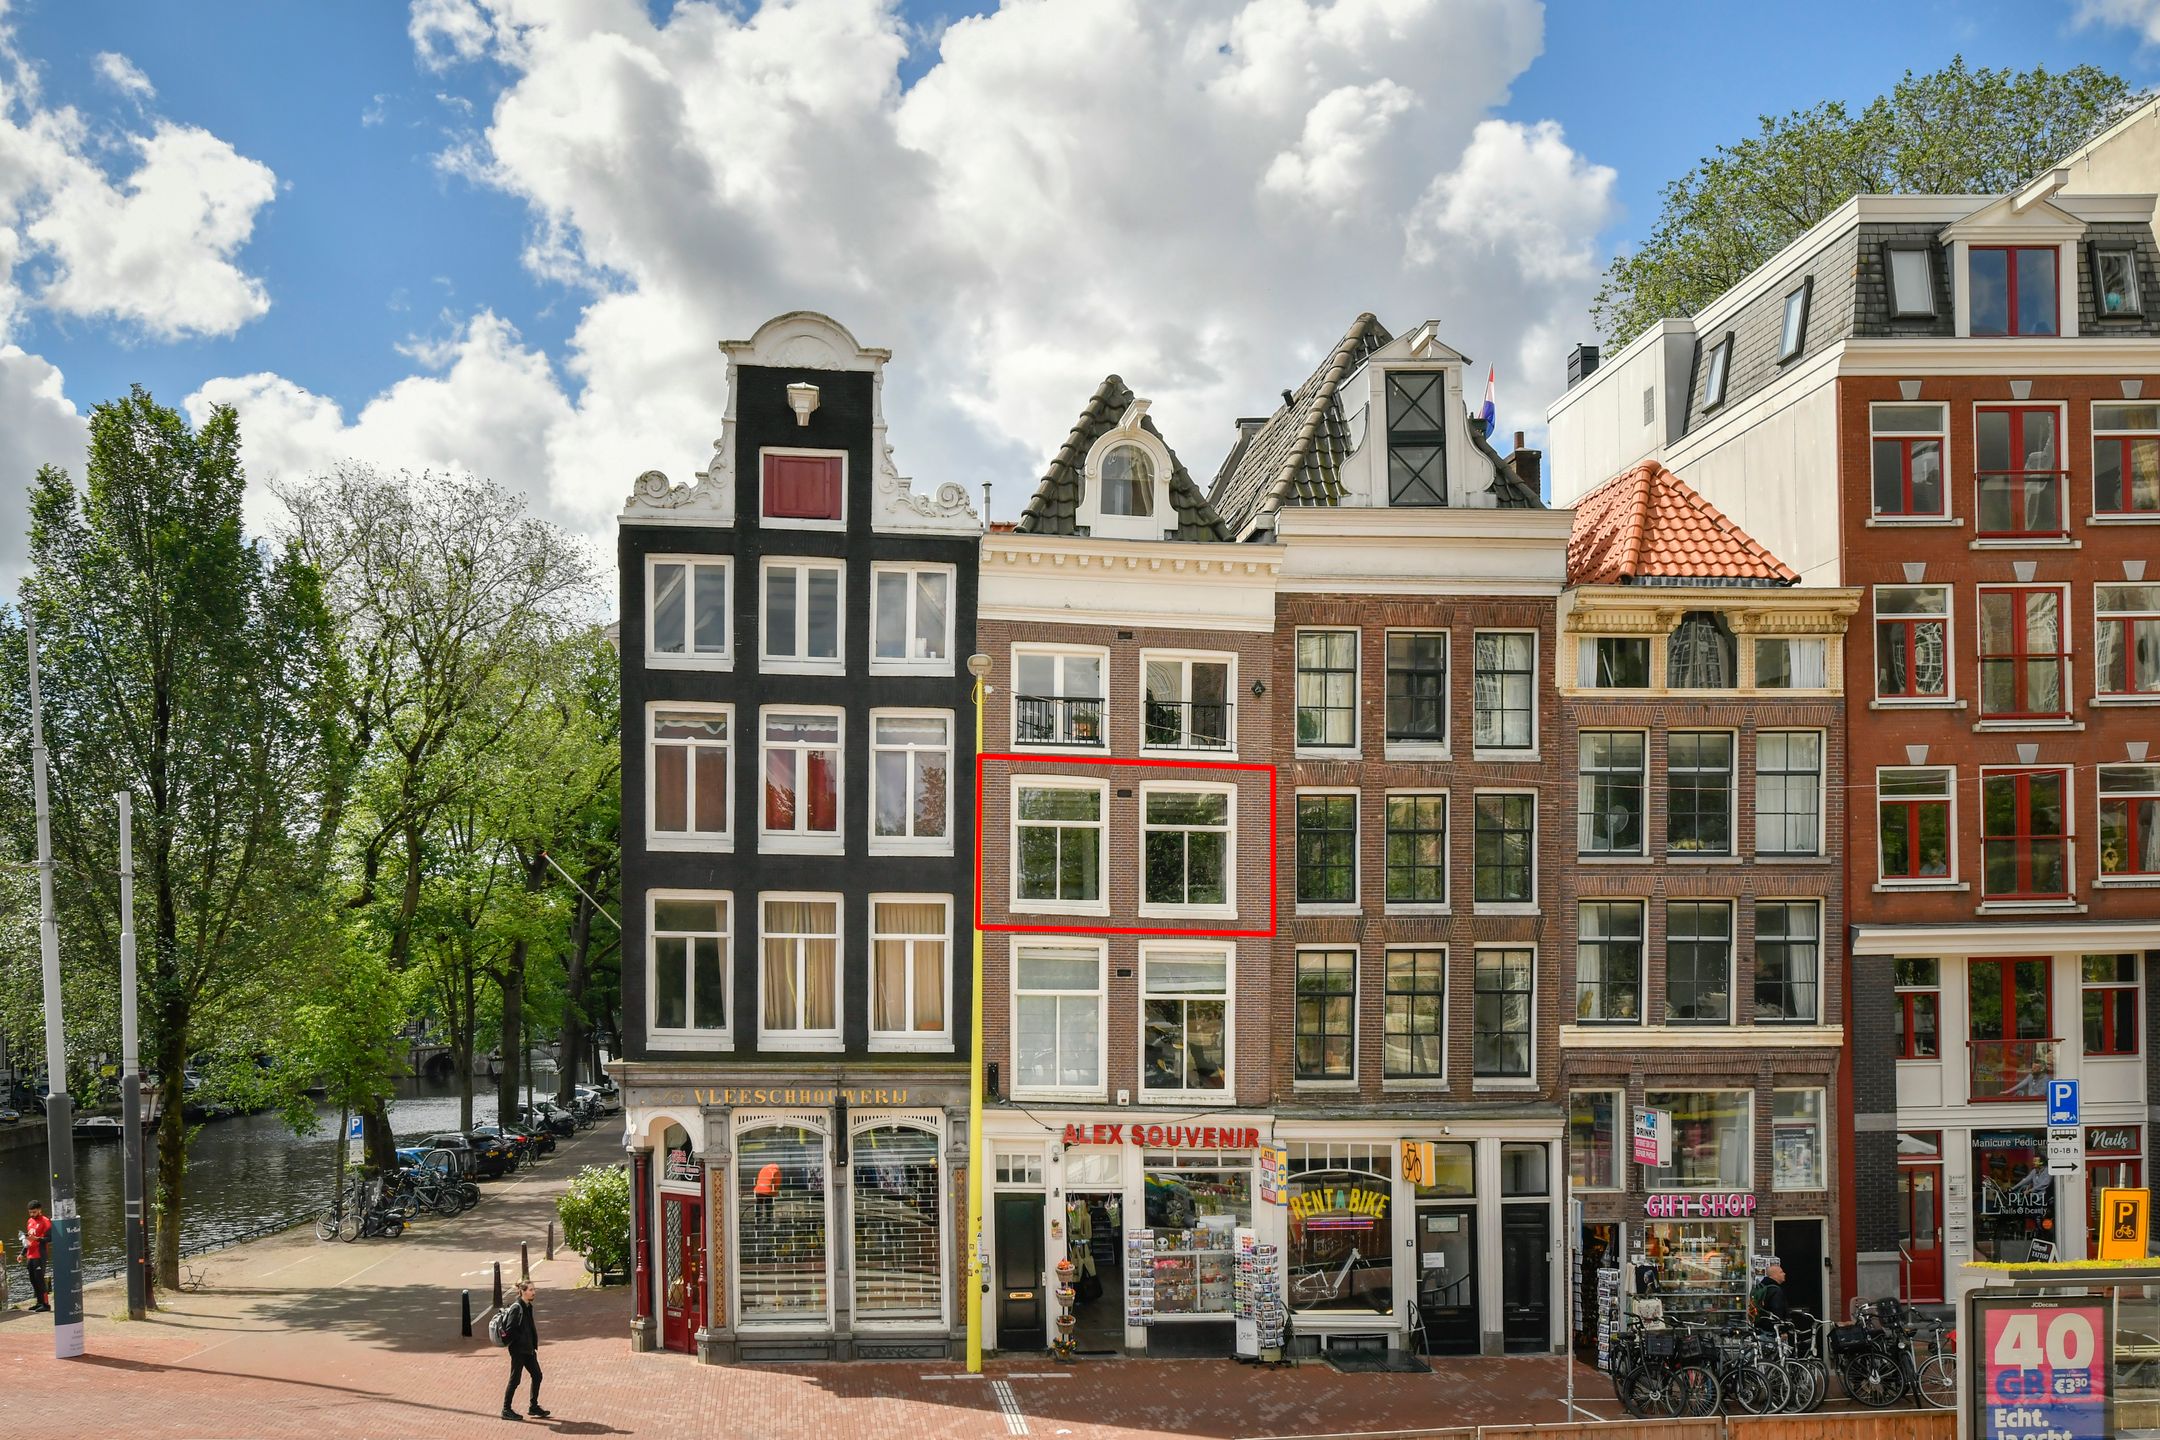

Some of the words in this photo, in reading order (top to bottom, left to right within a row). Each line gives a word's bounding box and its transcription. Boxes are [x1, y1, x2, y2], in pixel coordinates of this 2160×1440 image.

[694, 1087, 908, 1105] VLEESCHHOUWERIJ
[2056, 1084, 2072, 1107] P
[352, 1118, 360, 1131] P
[1636, 1127, 1656, 1139] DRINKS
[1062, 1124, 1123, 1145] ALEX
[1131, 1124, 1260, 1148] SOUVENIR
[1972, 1138, 2011, 1148] Manicure
[2091, 1130, 2129, 1149] Nails
[1289, 1188, 1334, 1220] RENT
[1335, 1189, 1346, 1209] A
[1348, 1188, 1391, 1219] BIKE
[1646, 1194, 1691, 1217] GIFT
[1699, 1193, 1756, 1217] SHOP
[2008, 1192, 2048, 1207] PEARL
[2118, 1202, 2134, 1223] P
[1995, 1312, 2095, 1372] 40
[1996, 1368, 2044, 1399] GB
[1994, 1408, 2049, 1428] Echt.
